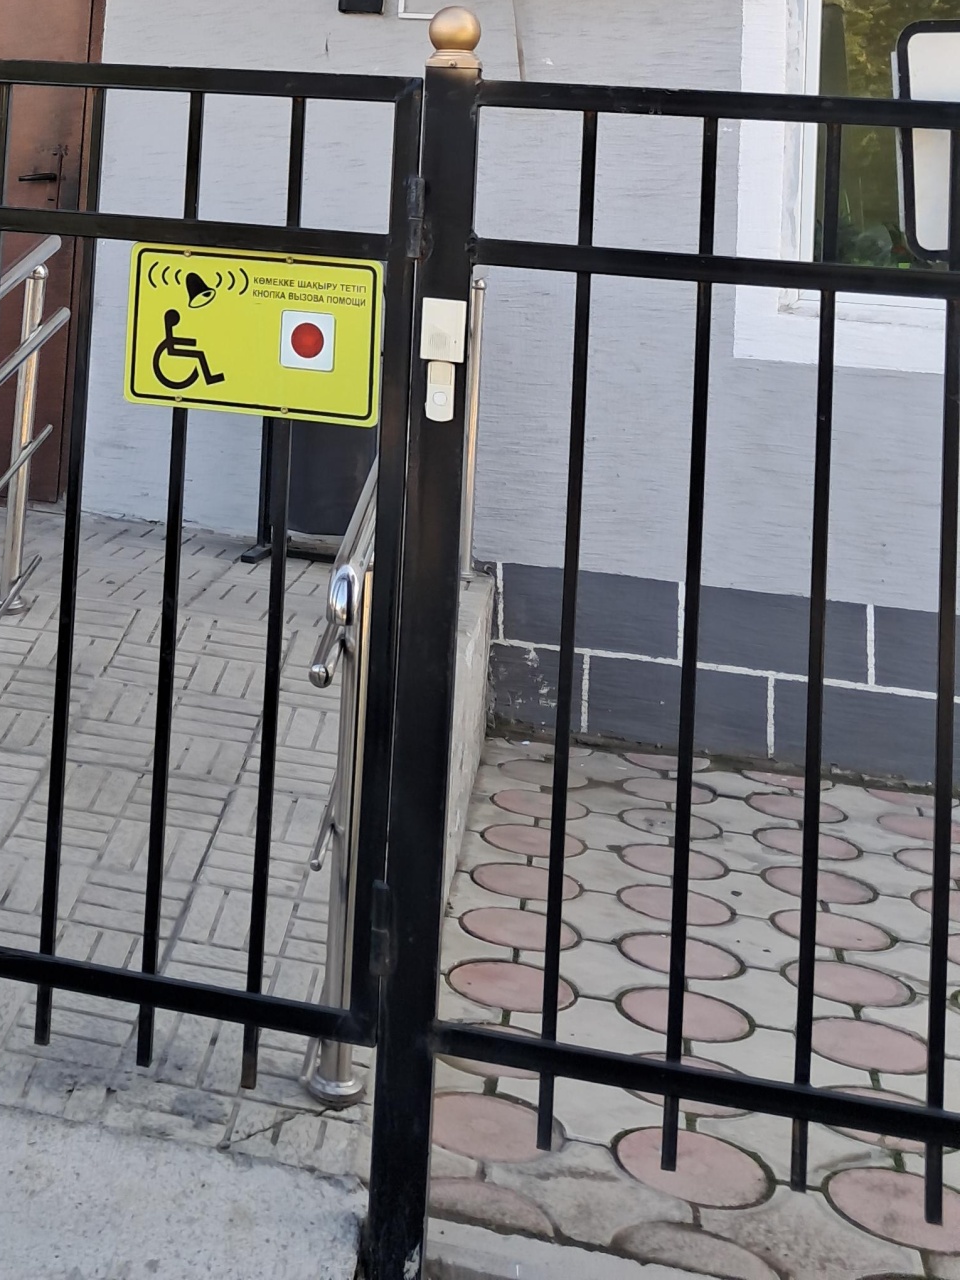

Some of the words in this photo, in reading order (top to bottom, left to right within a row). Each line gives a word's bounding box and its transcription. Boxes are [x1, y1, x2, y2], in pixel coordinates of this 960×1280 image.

[253, 276, 295, 288] КӨМЕККЕ
[297, 280, 338, 291] ШАҚЫРУ
[252, 289, 286, 300] КНОПКА
[288, 292, 324, 303] ВЫЗОВА
[326, 295, 366, 307] ПОМОЩИ
